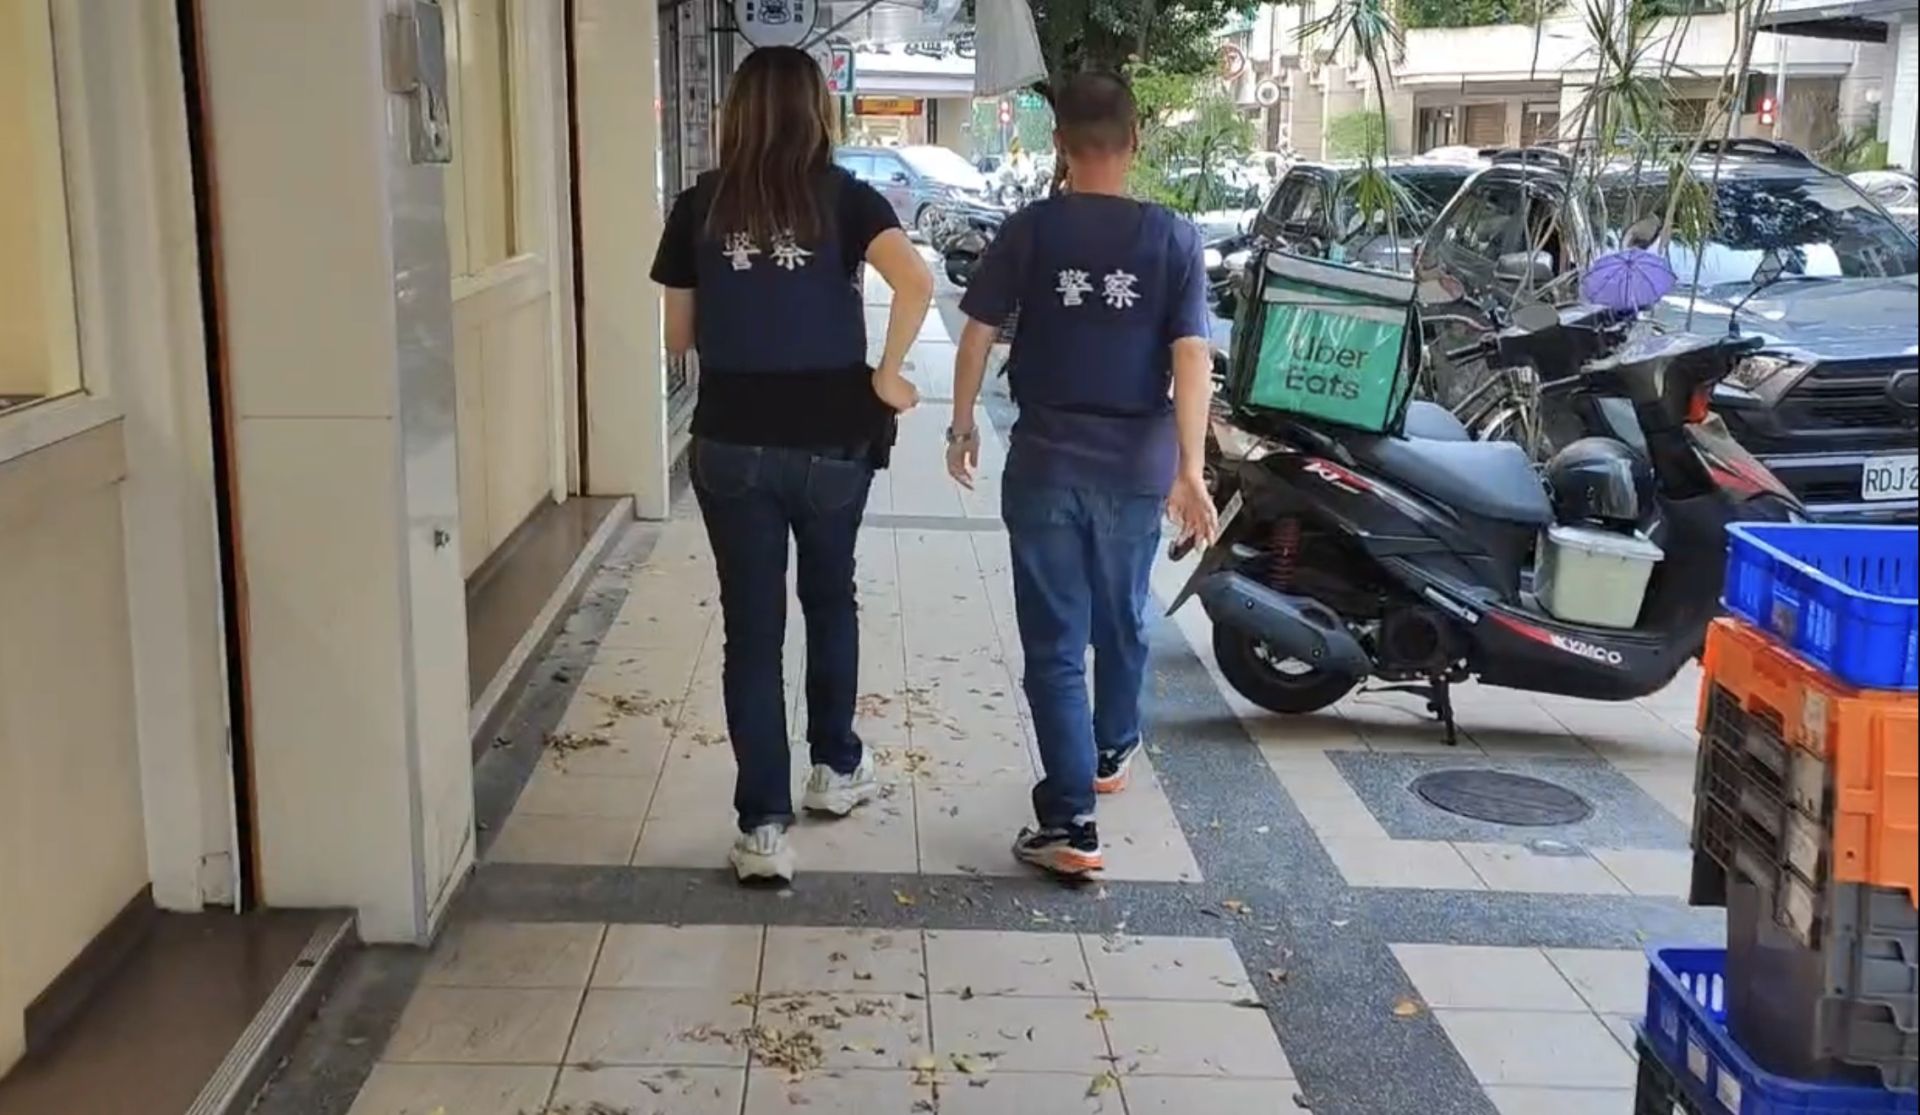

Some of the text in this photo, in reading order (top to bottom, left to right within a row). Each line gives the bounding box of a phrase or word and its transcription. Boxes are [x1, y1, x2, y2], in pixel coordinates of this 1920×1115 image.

[722, 230, 813, 271] 警察
[1055, 269, 1141, 309] 警察
[1292, 333, 1368, 369] Uber
[1286, 365, 1359, 400] Eats
